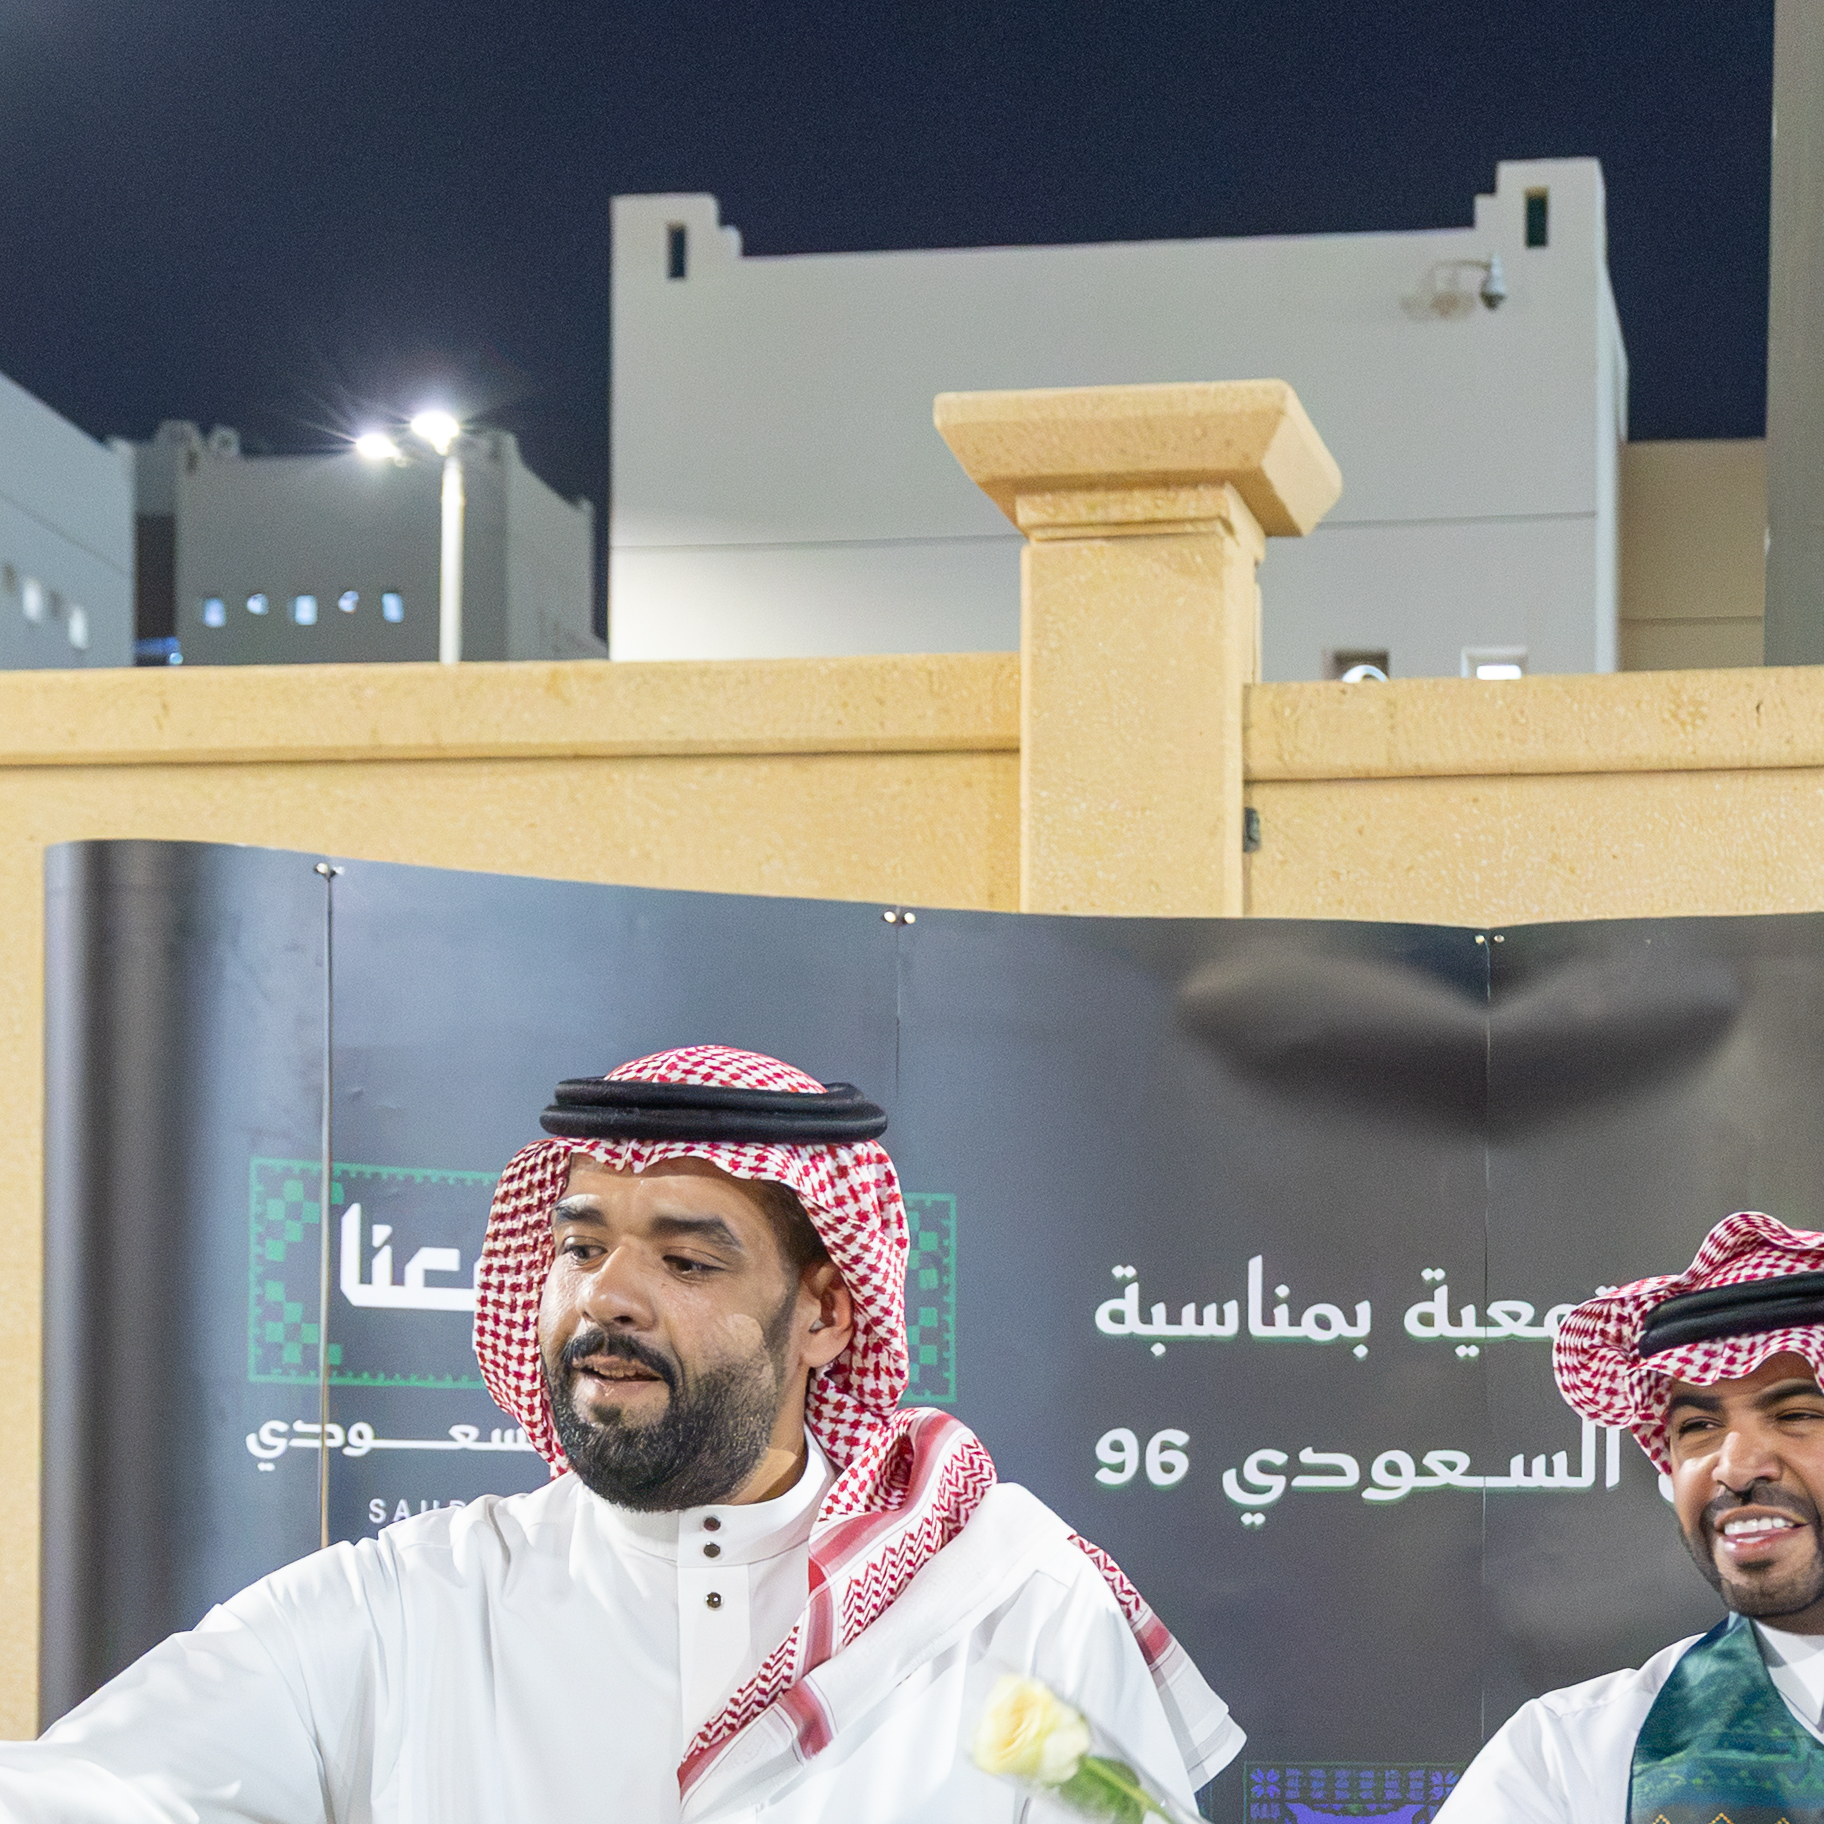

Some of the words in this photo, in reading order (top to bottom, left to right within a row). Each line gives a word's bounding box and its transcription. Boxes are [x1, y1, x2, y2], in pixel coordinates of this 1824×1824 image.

[1094, 1254, 1372, 1359] بمناسبة
[1094, 1427, 1191, 1486] 96
[1222, 1418, 1621, 1526] السعودي
